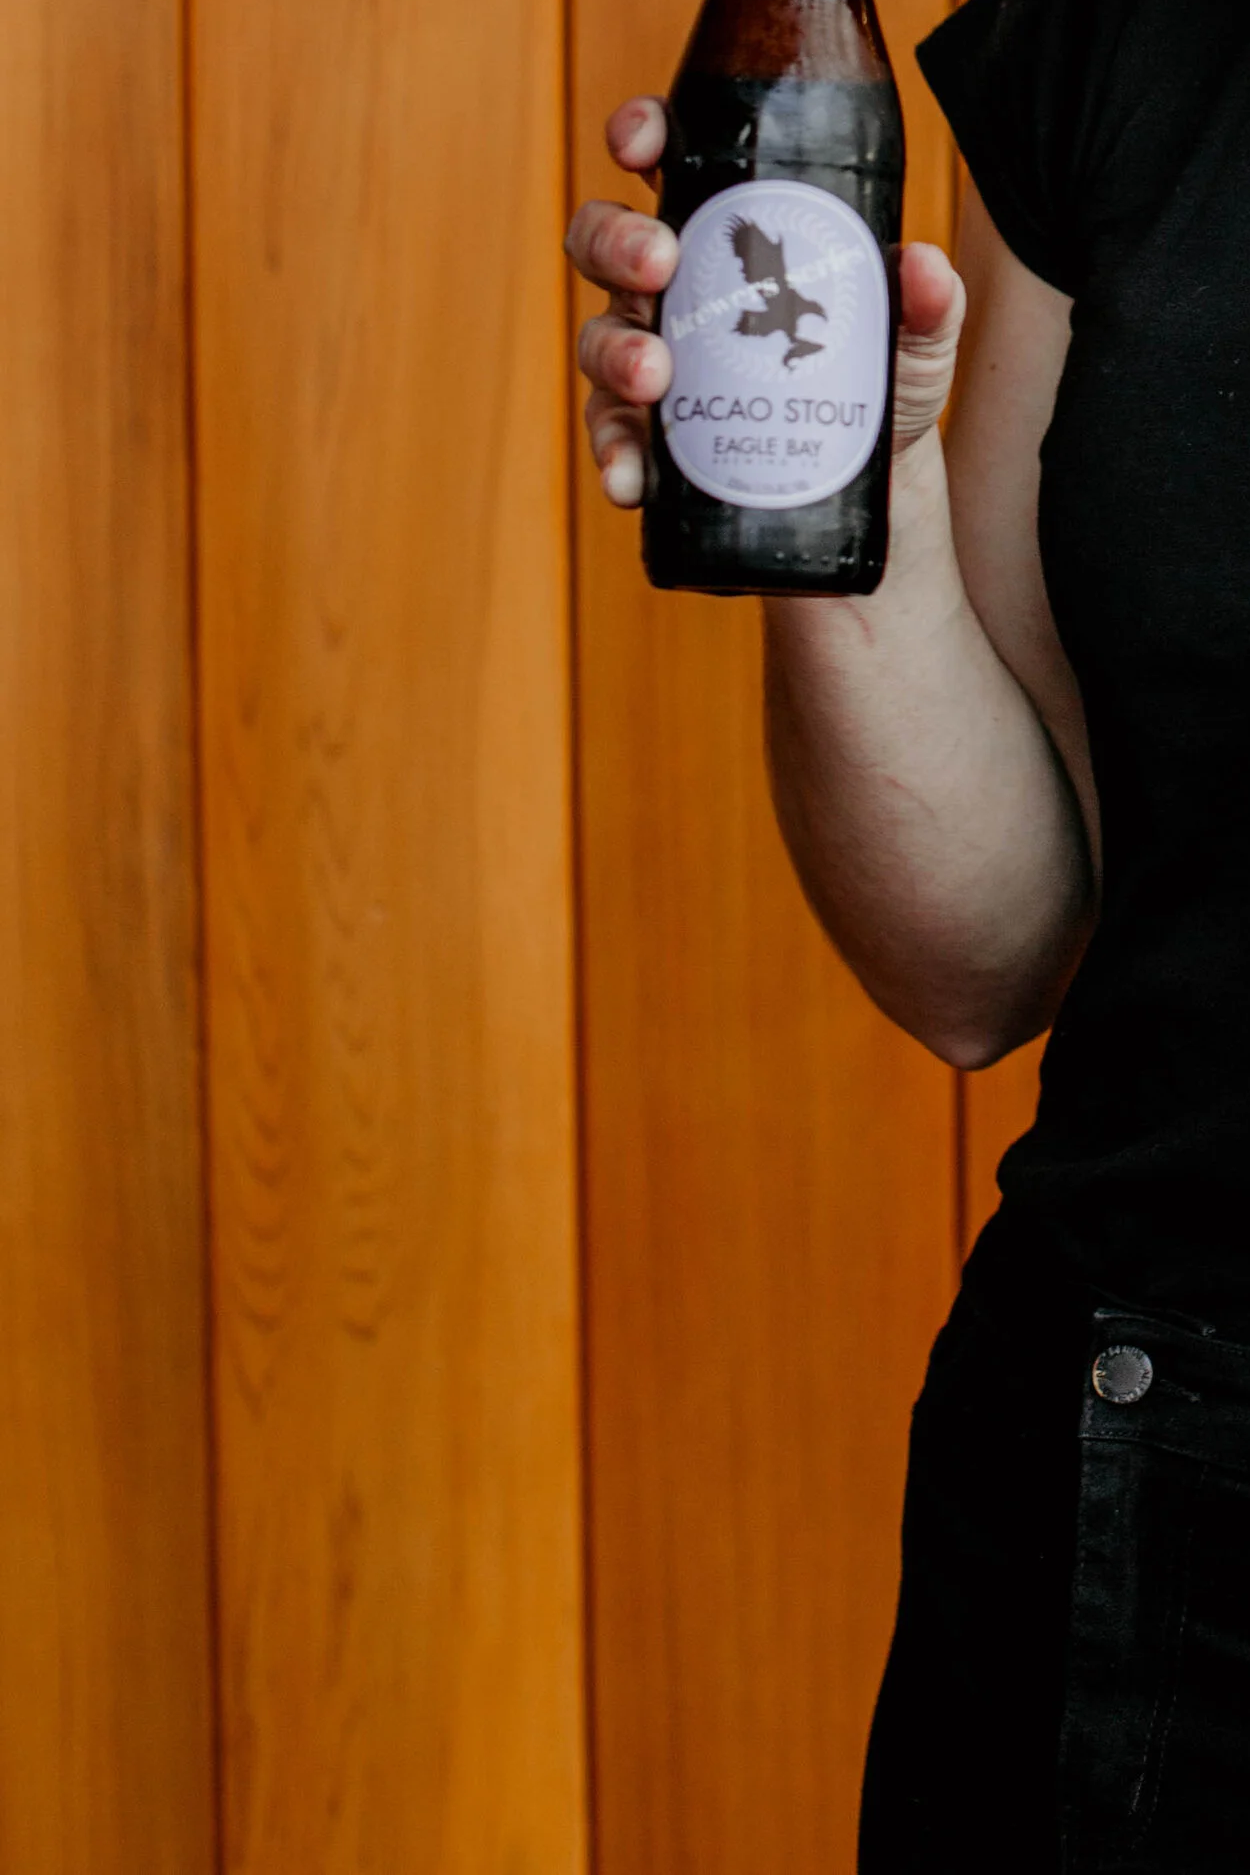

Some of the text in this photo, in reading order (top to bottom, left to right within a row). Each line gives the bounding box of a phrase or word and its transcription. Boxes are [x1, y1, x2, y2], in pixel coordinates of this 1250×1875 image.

[673, 395, 867, 428] CACAO STOUT
[713, 436, 823, 458] EAGLE BAY
